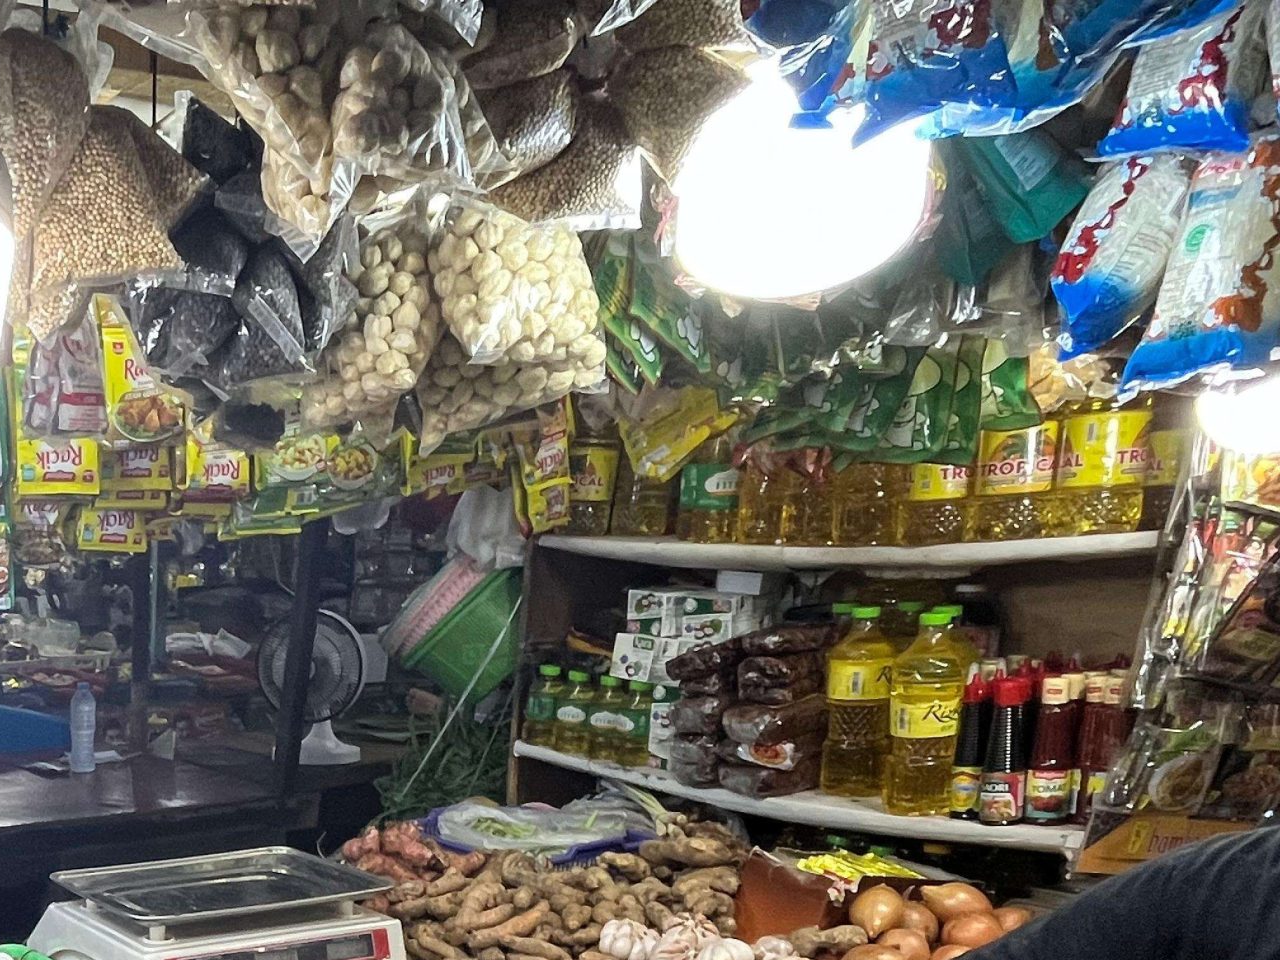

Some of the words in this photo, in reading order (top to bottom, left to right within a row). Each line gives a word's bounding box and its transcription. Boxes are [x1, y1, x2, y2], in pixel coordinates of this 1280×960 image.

[36, 445, 83, 470] Racik
[116, 446, 159, 467] Racik
[980, 457, 1057, 477] TROPCA
[203, 459, 241, 482] Racik
[97, 510, 135, 531] Racik
